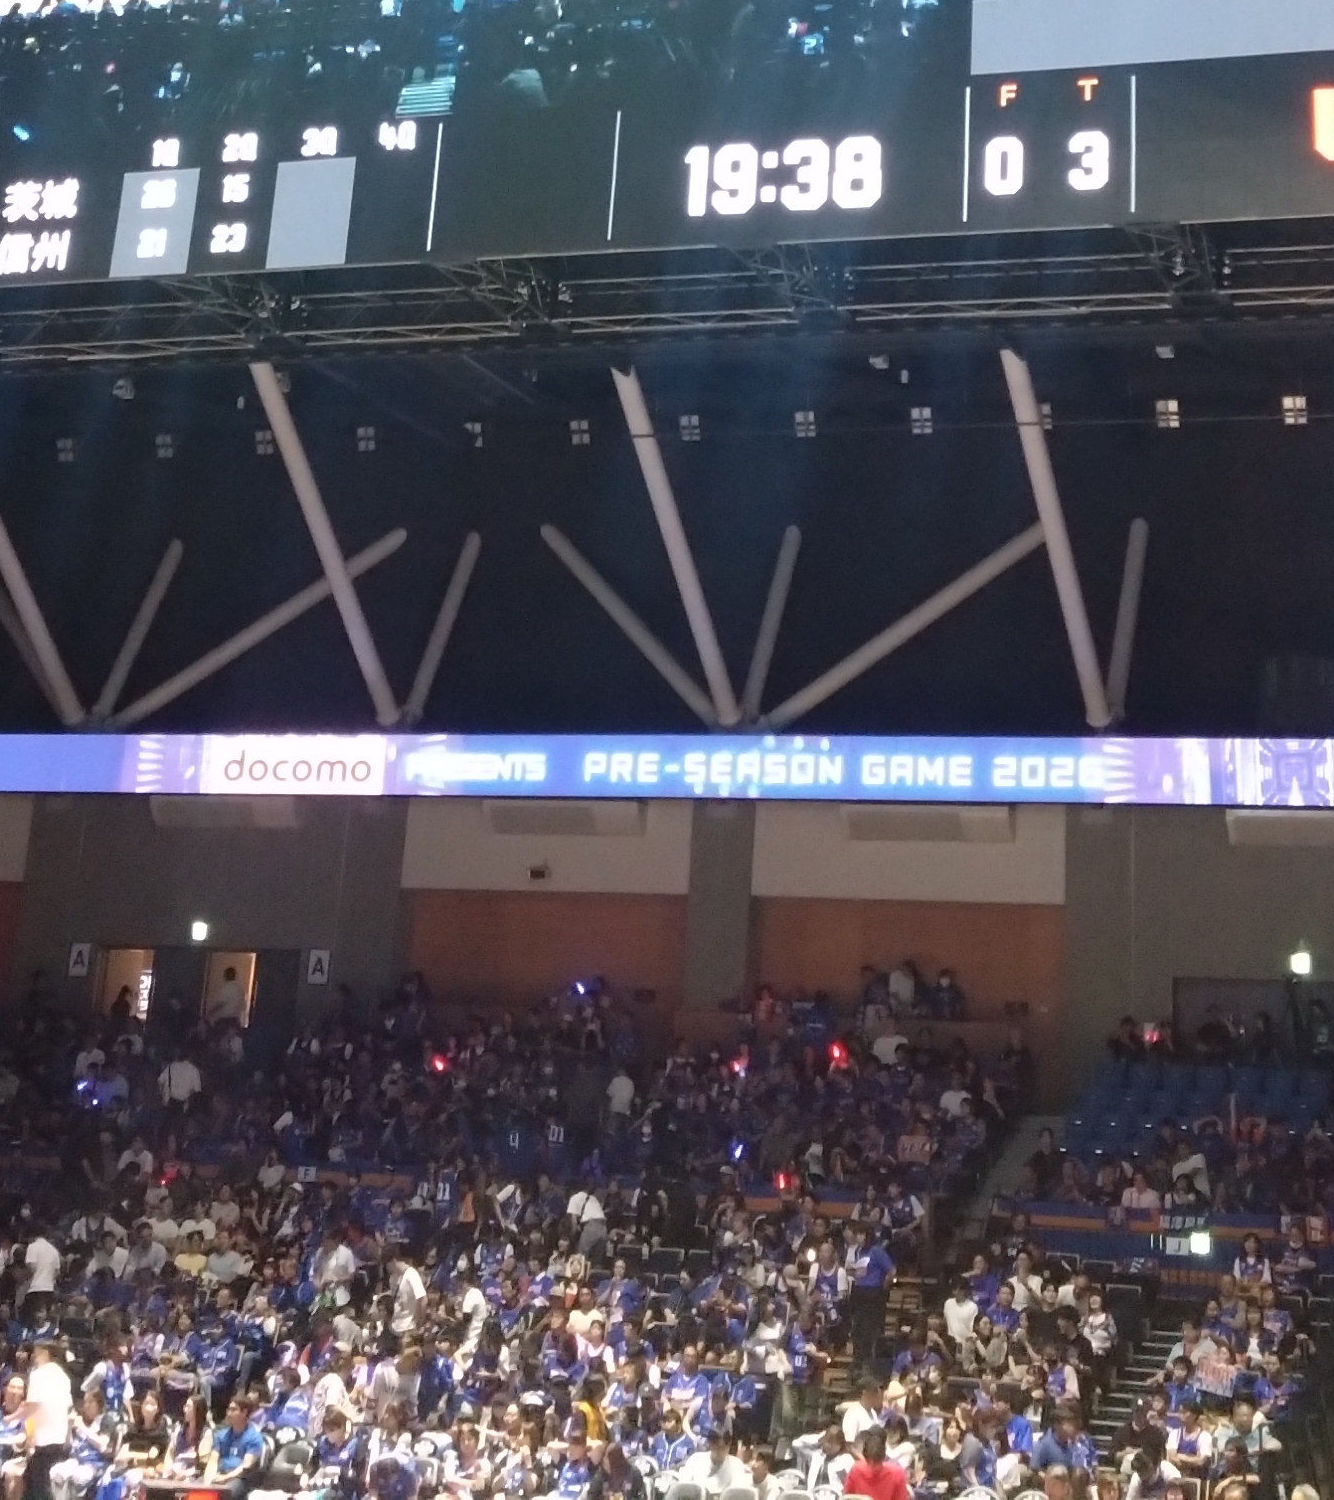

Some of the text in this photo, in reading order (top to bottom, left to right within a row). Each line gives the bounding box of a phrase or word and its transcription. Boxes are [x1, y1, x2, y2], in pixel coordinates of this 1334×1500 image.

[999, 77, 1099, 107] F T
[684, 135, 883, 217] 19:38
[984, 130, 1110, 196] 0 3
[1, 177, 80, 223] 茨城
[222, 173, 250, 203] 15
[210, 223, 247, 253] 23
[224, 749, 372, 783] docomo
[405, 753, 546, 781] PSENTS
[584, 752, 842, 785] PRE-SEASON
[862, 755, 972, 786] GAME
[72, 950, 86, 969] A
[311, 956, 325, 976] A
